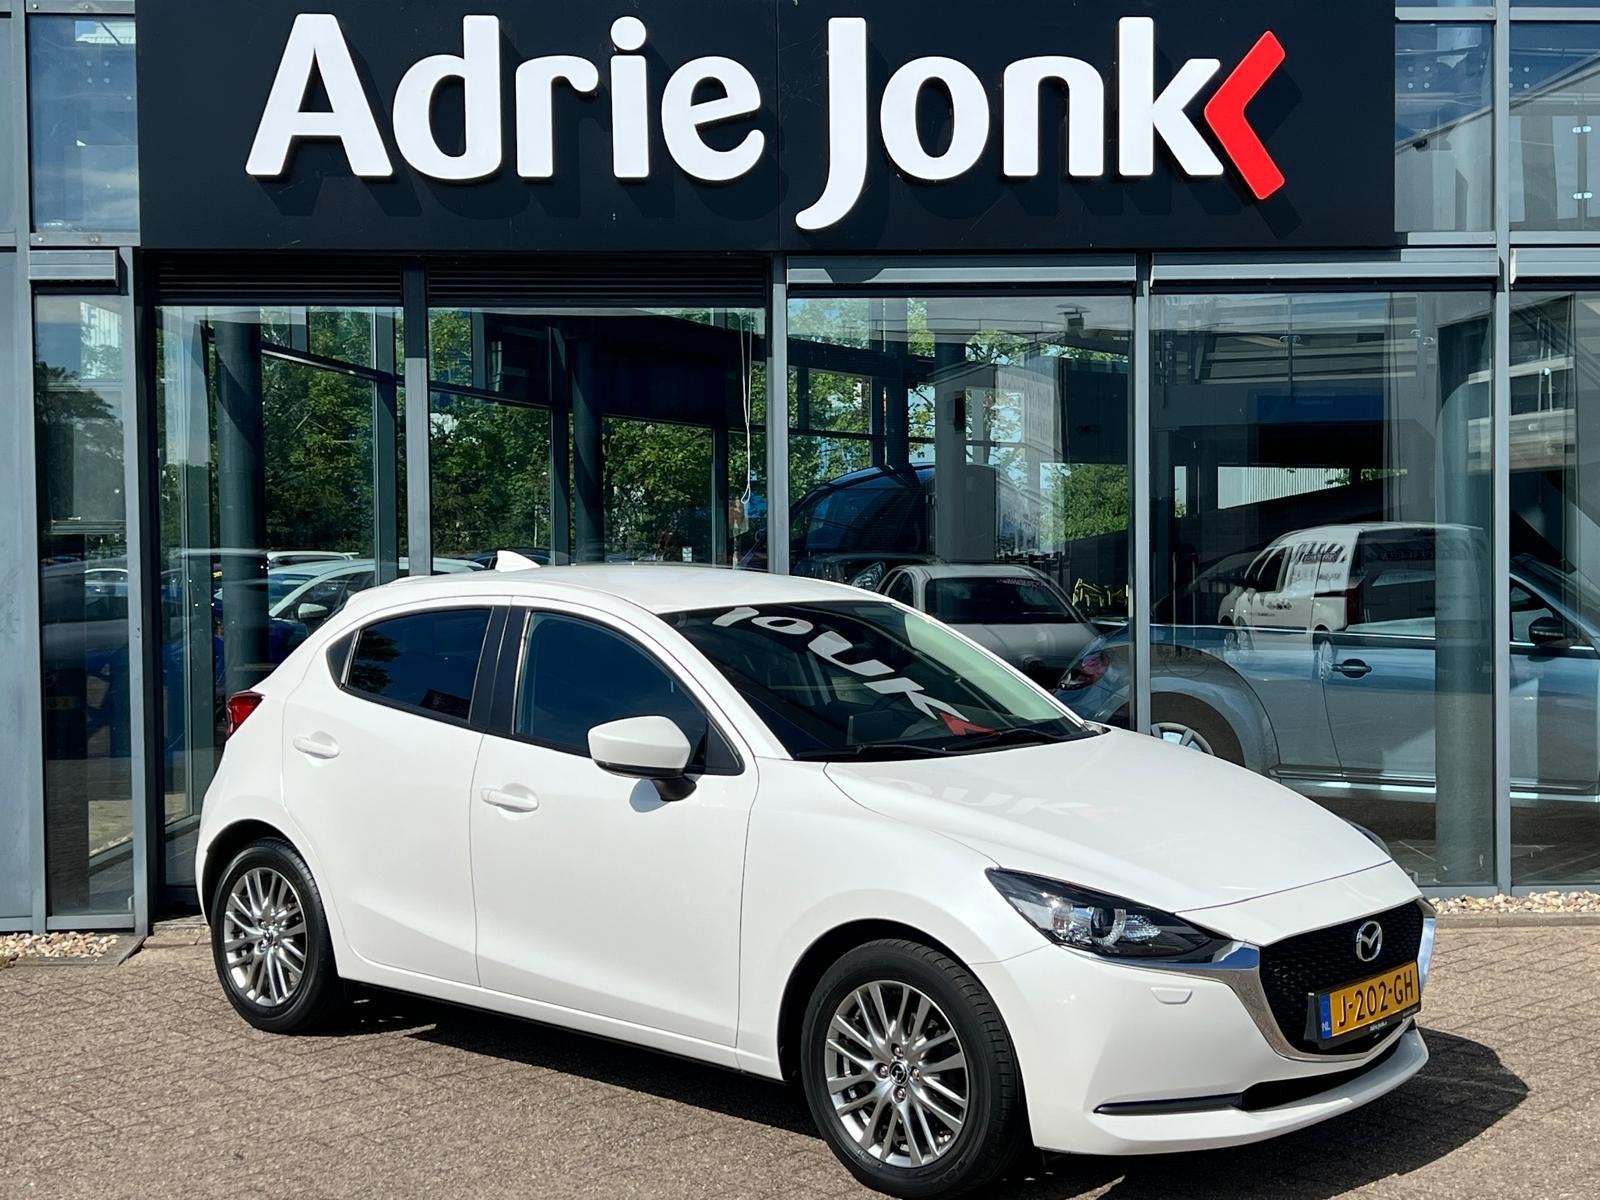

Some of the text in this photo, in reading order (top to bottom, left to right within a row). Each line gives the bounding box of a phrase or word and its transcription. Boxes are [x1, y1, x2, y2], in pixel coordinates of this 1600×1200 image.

[245, 13, 1225, 231] Adrie Jonk
[1337, 969, 1414, 1028] J-202-GH
